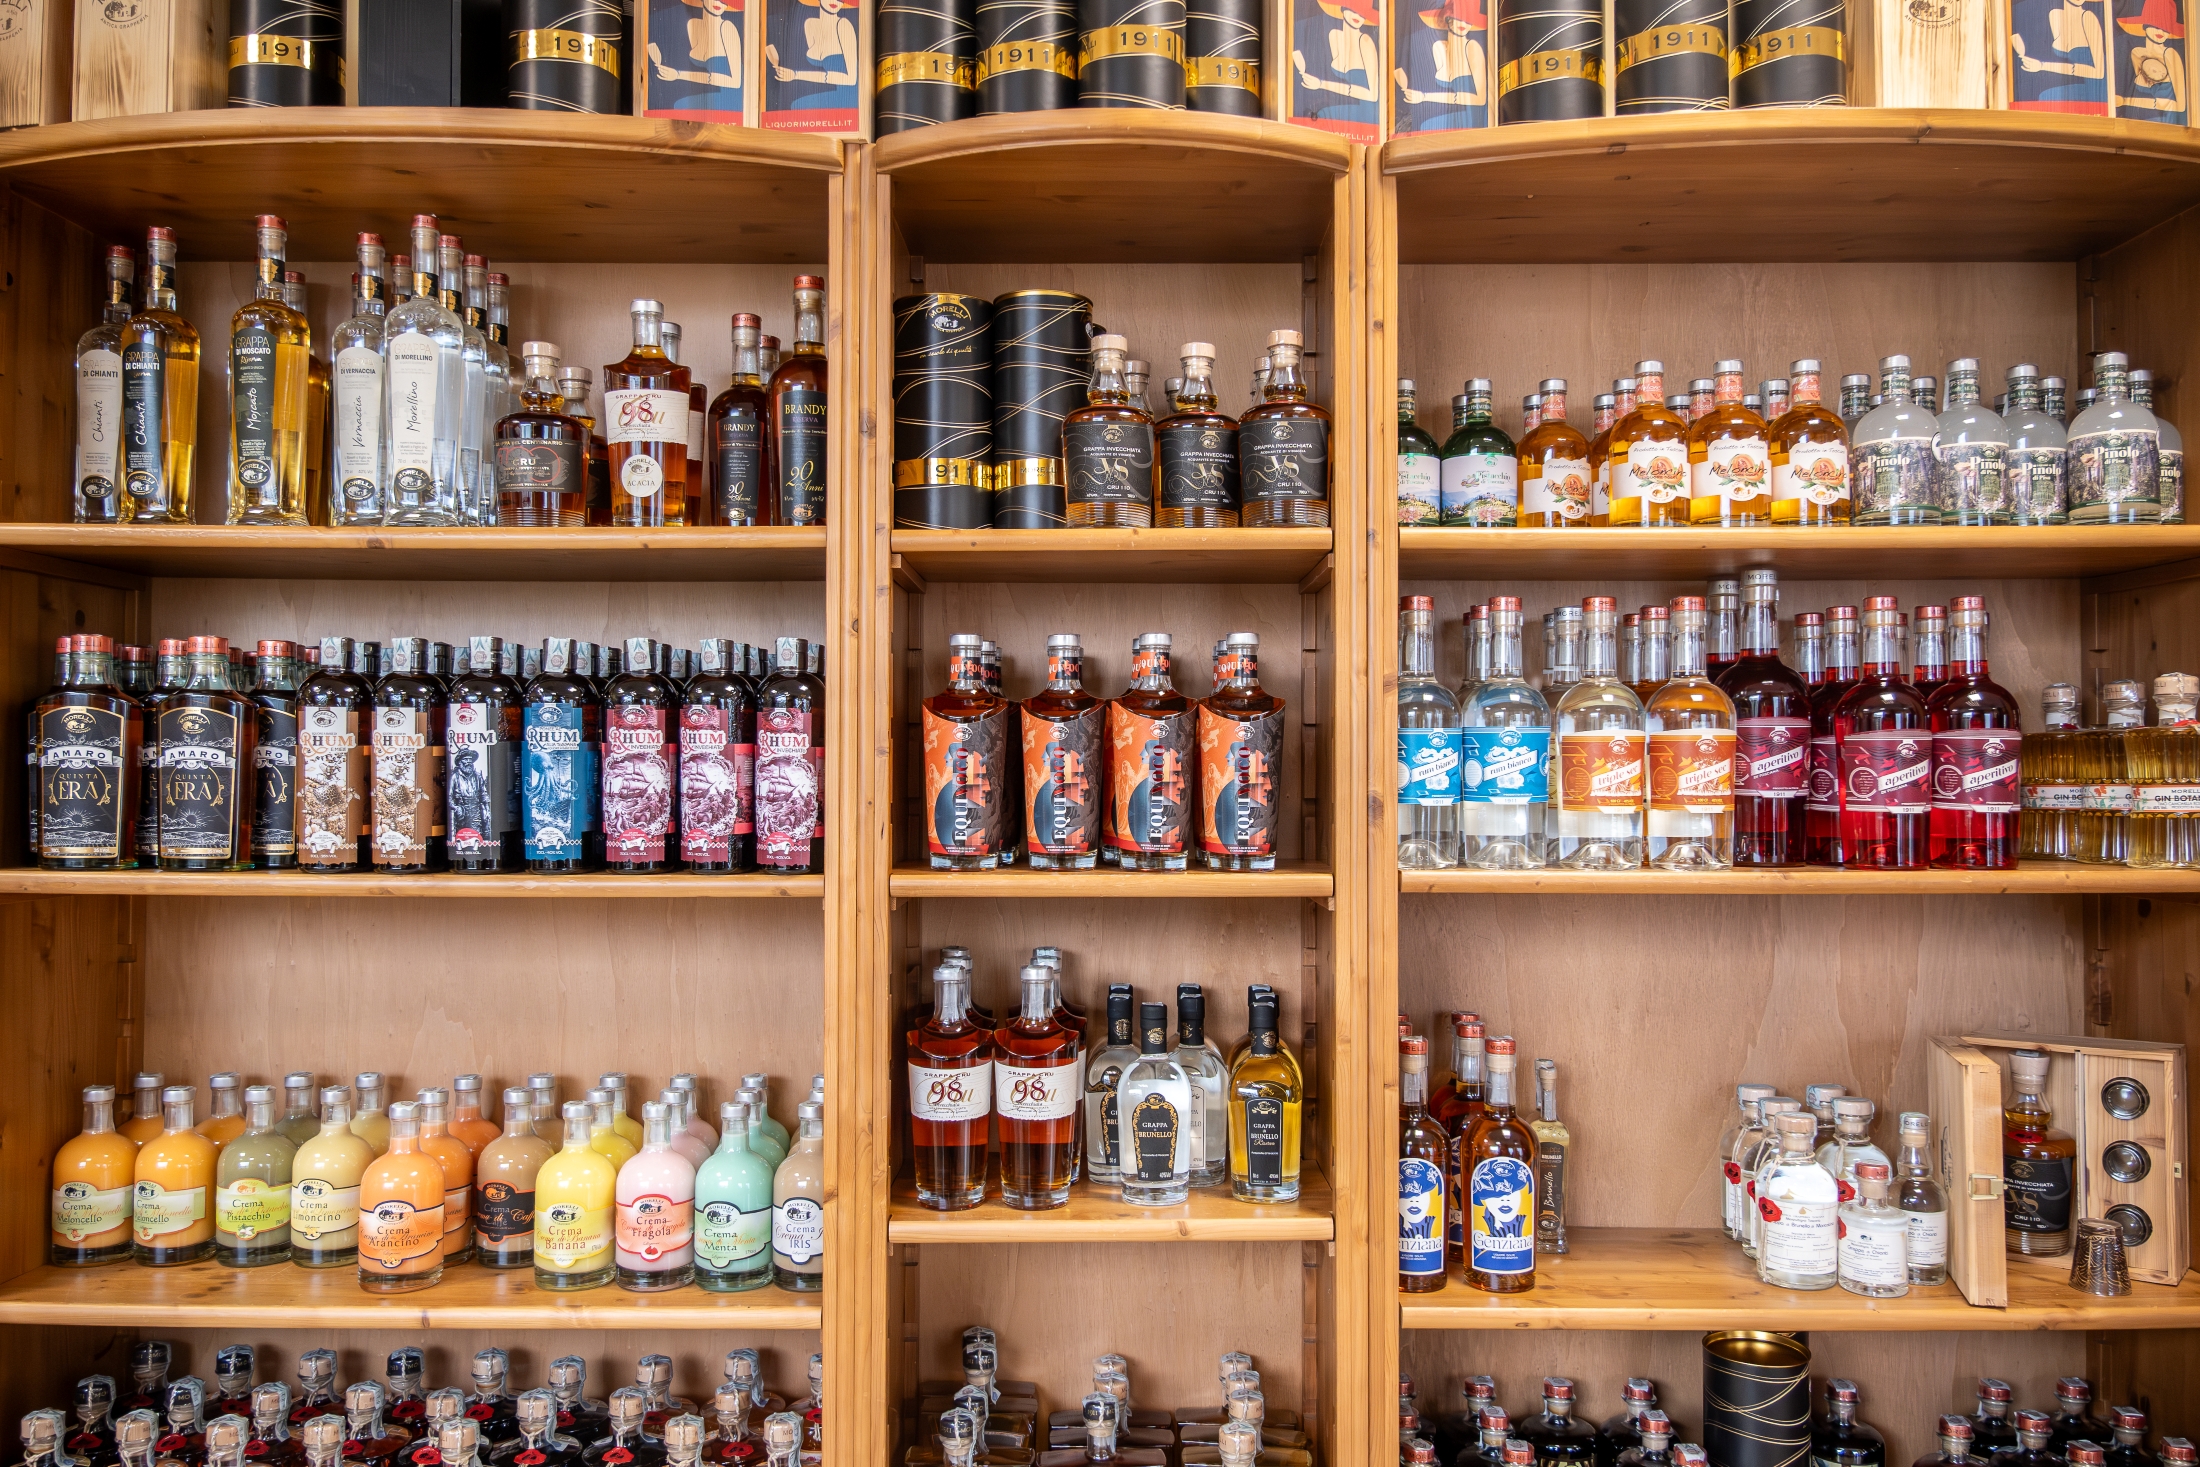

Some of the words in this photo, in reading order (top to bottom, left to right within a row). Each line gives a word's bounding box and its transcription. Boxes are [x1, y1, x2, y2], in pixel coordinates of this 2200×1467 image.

[1904, 14, 1925, 28] ANTICA
[1120, 32, 1171, 52] 1911
[1653, 31, 1709, 49] 1911
[998, 48, 1049, 65] 1911
[1215, 64, 1256, 87] 1911
[765, 119, 852, 129] LIQUORIMORELLI.IT
[929, 306, 968, 319] MORELLI
[235, 337, 269, 348] GRAPPA
[125, 352, 160, 363] GRAPPA
[242, 347, 271, 355] MOSCATO
[132, 362, 160, 370] CHIANTI
[90, 370, 119, 378] CHIANTI
[247, 387, 257, 430] Moscato
[407, 381, 417, 432] Morellino
[622, 397, 654, 426] 98
[785, 404, 827, 416] BRANDY
[92, 400, 104, 442] Chianti
[135, 401, 146, 446] Chianti
[723, 423, 755, 432] BRANDY
[2093, 446, 2139, 460] Pinolo
[1867, 454, 1909, 468] Pinolo
[1970, 456, 2006, 471] Pinolo
[395, 468, 428, 481] MORELLI
[2021, 462, 2062, 477] Pinolo
[64, 714, 93, 724] MORELLI
[180, 714, 208, 724] MORELLI
[300, 732, 353, 757] RHUM
[374, 732, 422, 757] RHUM
[448, 730, 494, 754] RHUM
[528, 728, 578, 750] RHUM
[611, 731, 661, 754] RHUM
[760, 735, 807, 757] RHUM
[53, 749, 106, 759] AMARO
[169, 750, 219, 760] AMARO
[1757, 749, 1799, 772] aperitivo
[1419, 766, 1434, 776] rum
[1436, 758, 1456, 771] bianco
[1490, 766, 1506, 775] rum
[1507, 757, 1532, 770] bianco
[1598, 770, 1624, 786] triple
[1626, 764, 1638, 775] sec
[1685, 770, 1711, 785] triple
[1714, 764, 1727, 775] sec
[1885, 764, 1927, 787] aperitivo
[1969, 764, 2014, 786] aperitivo
[58, 781, 99, 800] ERA
[174, 782, 212, 800] ERA
[955, 747, 971, 841] EQUIVOCO
[1053, 746, 1071, 840] EQUIVOCO
[1150, 744, 1167, 839] EQUIVOCO
[1237, 746, 1255, 841] EQUIVOCO
[931, 1080, 963, 1104] 98
[1015, 1079, 1046, 1104] 98
[2014, 1179, 2054, 1188] INVECCHIATA
[62, 1202, 92, 1212] Crema
[136, 1201, 160, 1211] Crema
[232, 1199, 264, 1208] Crema
[299, 1200, 328, 1210] Crema
[484, 1203, 510, 1213] Crema
[707, 1204, 735, 1212] MORELLI
[56, 1213, 102, 1223] Meloncello
[227, 1211, 271, 1222] Pistacchio
[293, 1211, 341, 1222] Limoncino
[636, 1216, 667, 1224] Crema
[377, 1226, 409, 1235] Crema
[548, 1226, 583, 1235] Crema
[632, 1227, 671, 1240] Fragola
[704, 1228, 737, 1238] Crema
[786, 1223, 816, 1233] Crema
[369, 1235, 420, 1247] Arancino
[545, 1239, 586, 1250] Banana
[704, 1242, 737, 1251] Menta
[789, 1239, 811, 1249] IRIS
[1473, 1230, 1532, 1250] Genziana
